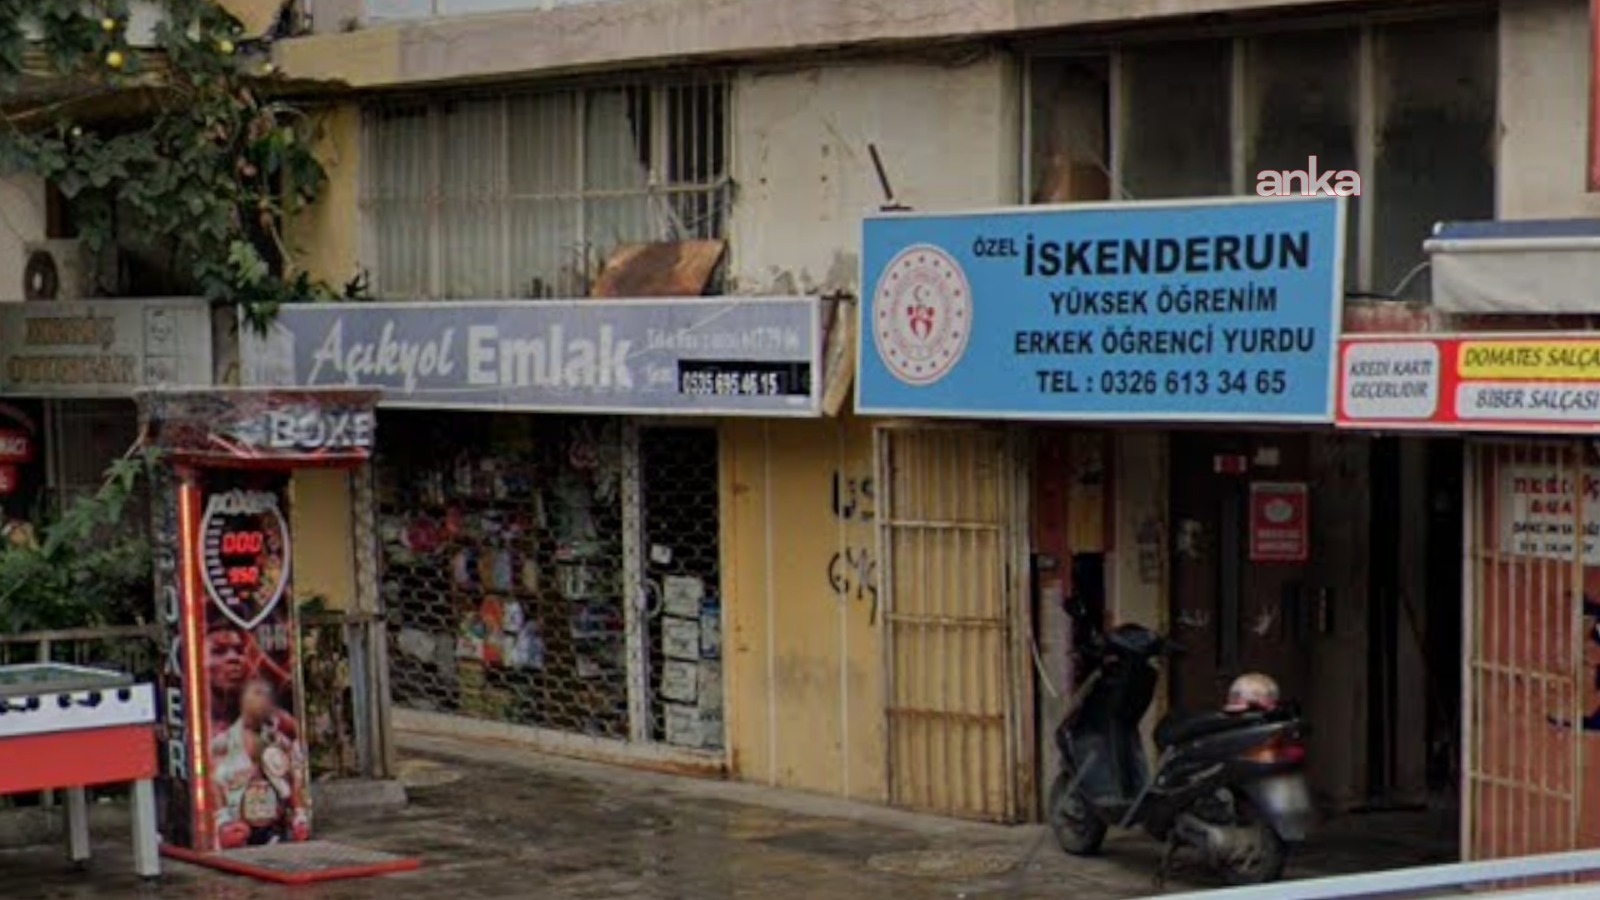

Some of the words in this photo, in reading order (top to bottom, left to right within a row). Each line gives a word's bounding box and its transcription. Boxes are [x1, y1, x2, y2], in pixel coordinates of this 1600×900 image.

[973, 237, 1019, 258] ÖZEL
[1024, 232, 1311, 277] İSKENDERUN
[1050, 287, 1148, 316] YÜKSEK
[1156, 281, 1278, 315] ÖĞRENİM
[1014, 331, 1093, 354] ERKEK
[1101, 324, 1213, 354] ÖĞRENCİ
[1222, 327, 1315, 352] YURDU
[467, 323, 633, 389] Emlak
[1463, 346, 1541, 367] DOMATES
[1036, 370, 1078, 394] TEL
[1101, 370, 1157, 394] 0326
[1164, 369, 1209, 394] 613
[1217, 370, 1247, 393] 34
[1255, 370, 1286, 393] 65
